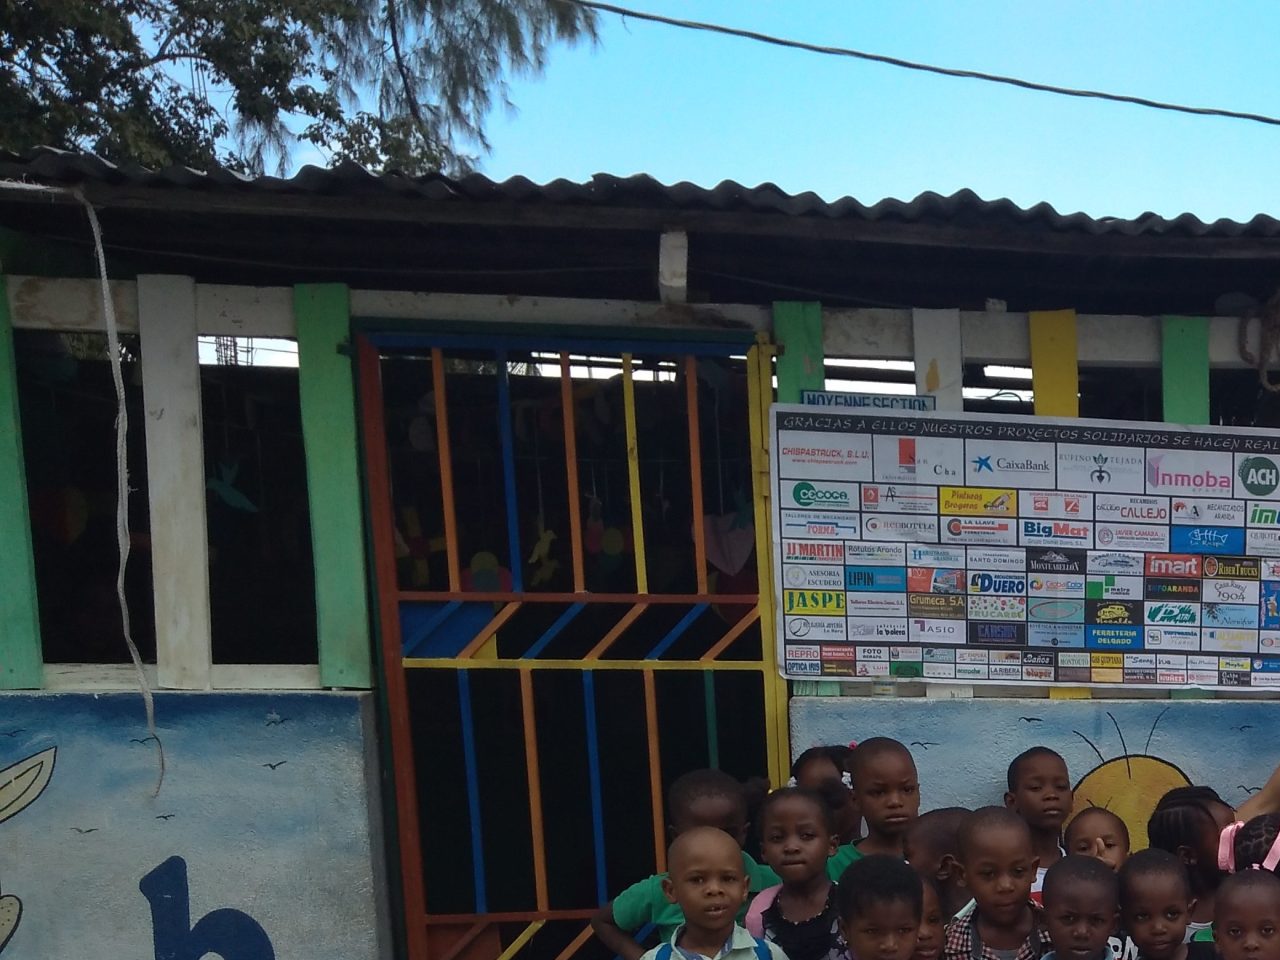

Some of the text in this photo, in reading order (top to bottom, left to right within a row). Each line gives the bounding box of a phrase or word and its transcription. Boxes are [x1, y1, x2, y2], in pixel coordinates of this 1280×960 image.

[784, 415, 852, 430] GRACIAS
[856, 419, 867, 432] A
[871, 420, 917, 432] ELLOS
[920, 422, 993, 437] NUESTROS
[998, 426, 1078, 441] PROYECTOS
[1082, 430, 1169, 445] SOLIDARIOS
[1172, 436, 1191, 446] SE
[1194, 437, 1241, 451] HACEN
[997, 457, 1051, 471] CaixaBank
[1246, 468, 1277, 486] ACH
[1120, 506, 1167, 520] CALLEJO
[1023, 521, 1089, 538] BigMat
[798, 543, 844, 557] MARTIN
[969, 556, 991, 564] SANTO
[993, 557, 1025, 565] DOMINGO
[1149, 555, 1198, 575] imart
[807, 579, 842, 587] ESCUDERO
[979, 573, 1025, 594] DUERO
[786, 591, 845, 612] JASPE
[787, 649, 819, 659] REPRO
